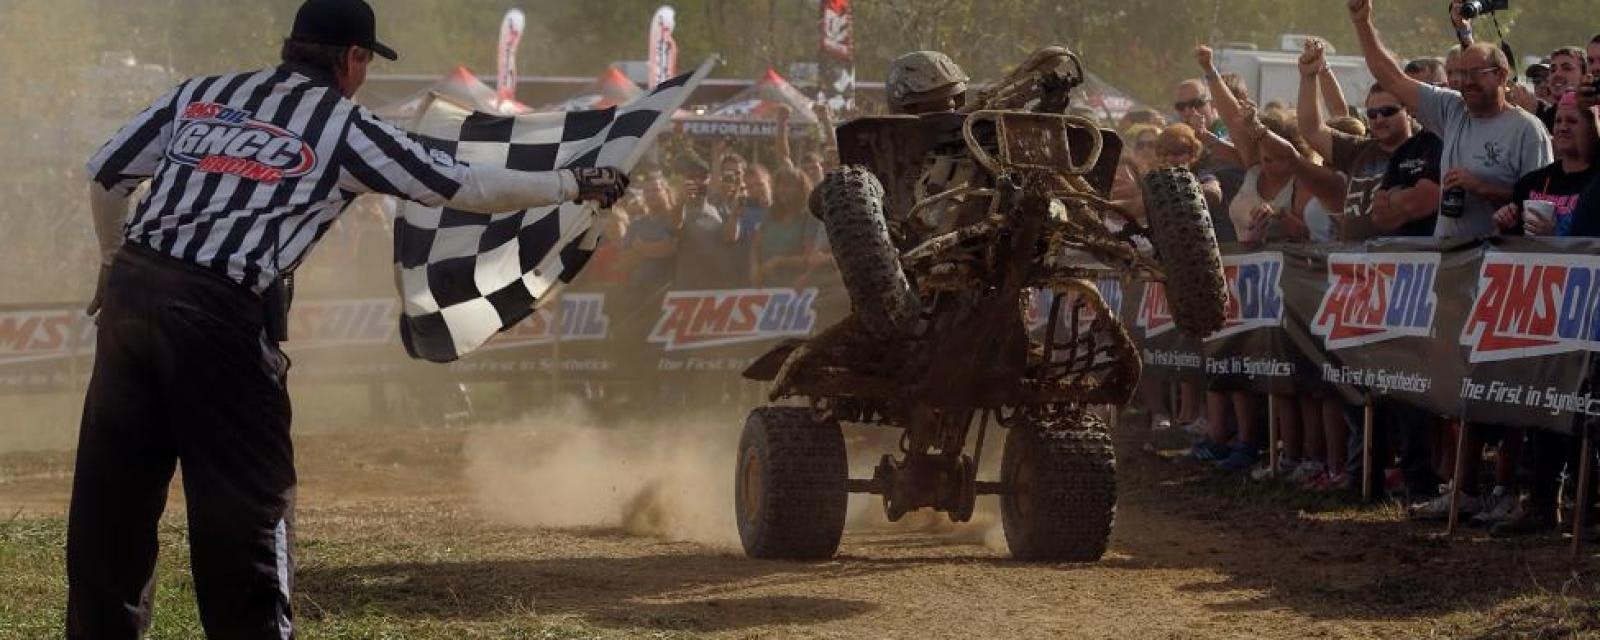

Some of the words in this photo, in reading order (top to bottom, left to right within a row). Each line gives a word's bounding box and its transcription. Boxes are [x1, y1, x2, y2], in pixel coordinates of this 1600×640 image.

[173, 124, 303, 167] GNCC
[199, 155, 284, 186] RACING
[656, 293, 814, 344] AMSOIL
[1317, 263, 1435, 340] AMSOIL
[1323, 363, 1340, 382] The
[1460, 378, 1484, 399] The
[1486, 381, 1522, 404] First
[1525, 385, 1541, 406] in
